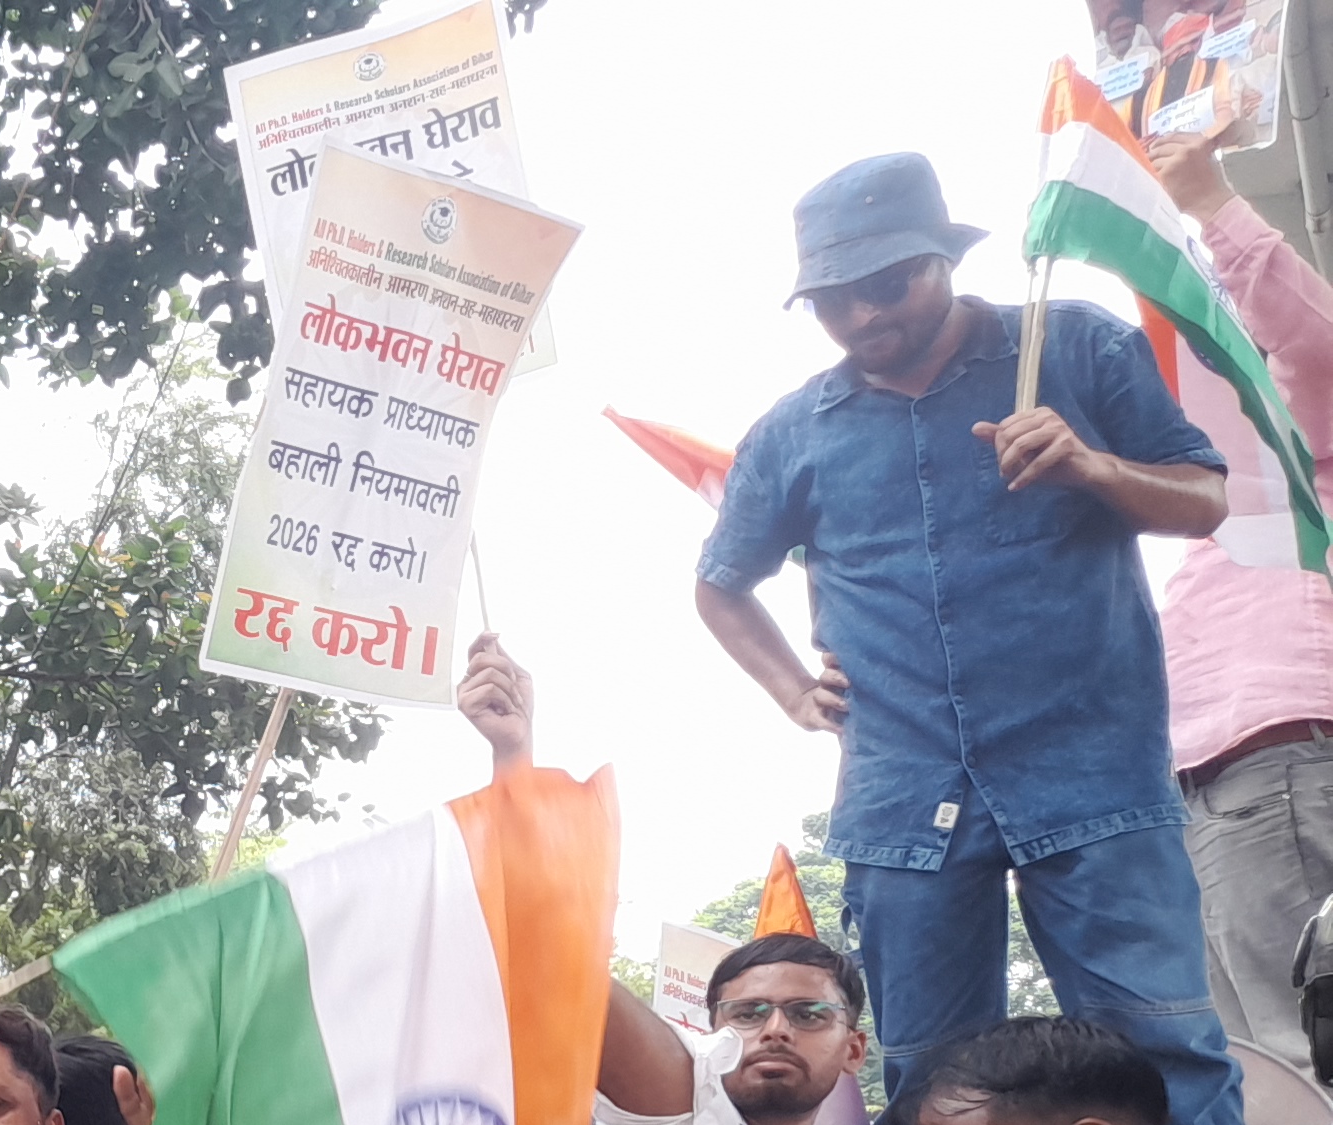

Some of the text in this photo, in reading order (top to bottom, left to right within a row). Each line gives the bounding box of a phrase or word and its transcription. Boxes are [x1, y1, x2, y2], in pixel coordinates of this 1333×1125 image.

[292, 107, 324, 123] Holders
[334, 93, 373, 111] Research
[375, 83, 411, 100] Scholars
[413, 65, 460, 90] Association
[472, 50, 494, 68] Bihar
[344, 104, 385, 125] आमरण
[422, 97, 502, 152] घेराव
[347, 227, 376, 257] Holders
[385, 243, 429, 270] Research
[429, 254, 457, 279] Scholars
[385, 274, 429, 301] आमरण
[300, 293, 506, 396] लोकभवन घेराव
[284, 366, 480, 449] सहायक प्राध्यापक
[268, 440, 461, 518] बहाली नियमावली
[266, 514, 427, 583] 2026 रद्द करो।
[234, 587, 300, 652] रद्द
